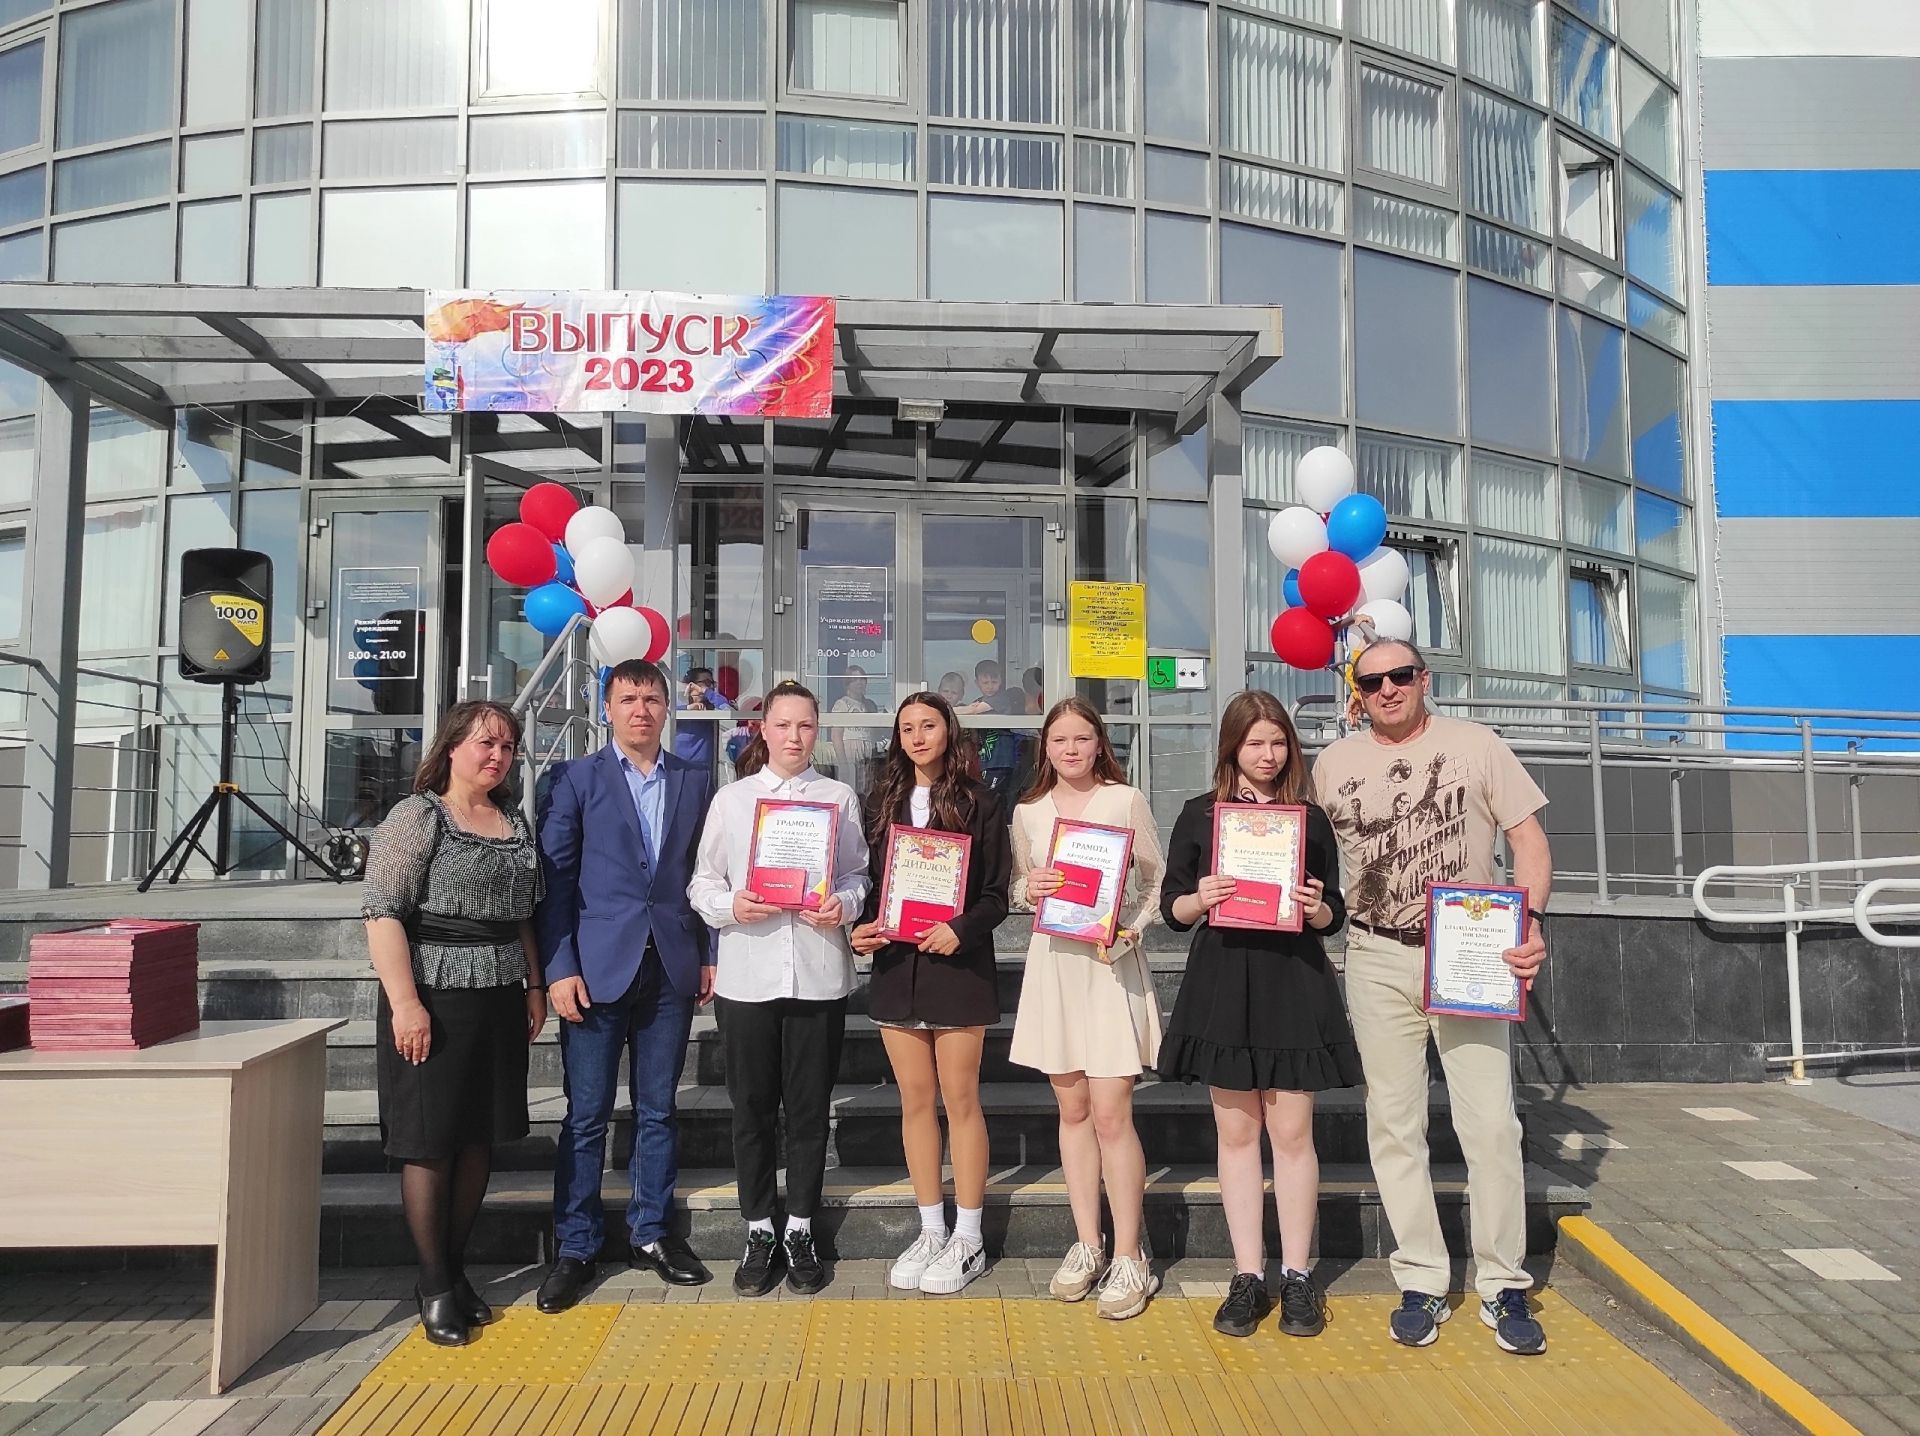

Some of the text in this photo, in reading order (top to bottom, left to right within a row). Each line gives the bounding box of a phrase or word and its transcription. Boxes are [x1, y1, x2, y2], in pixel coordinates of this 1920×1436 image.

[509, 310, 751, 358] ВЫПУСК
[584, 357, 696, 393] 2023
[216, 606, 258, 620] 1000
[377, 618, 402, 626] работы
[348, 651, 371, 660] 8.00
[379, 650, 406, 660] 21.00
[850, 649, 876, 658] 21.00
[901, 858, 952, 874] ДИПЛОМ
